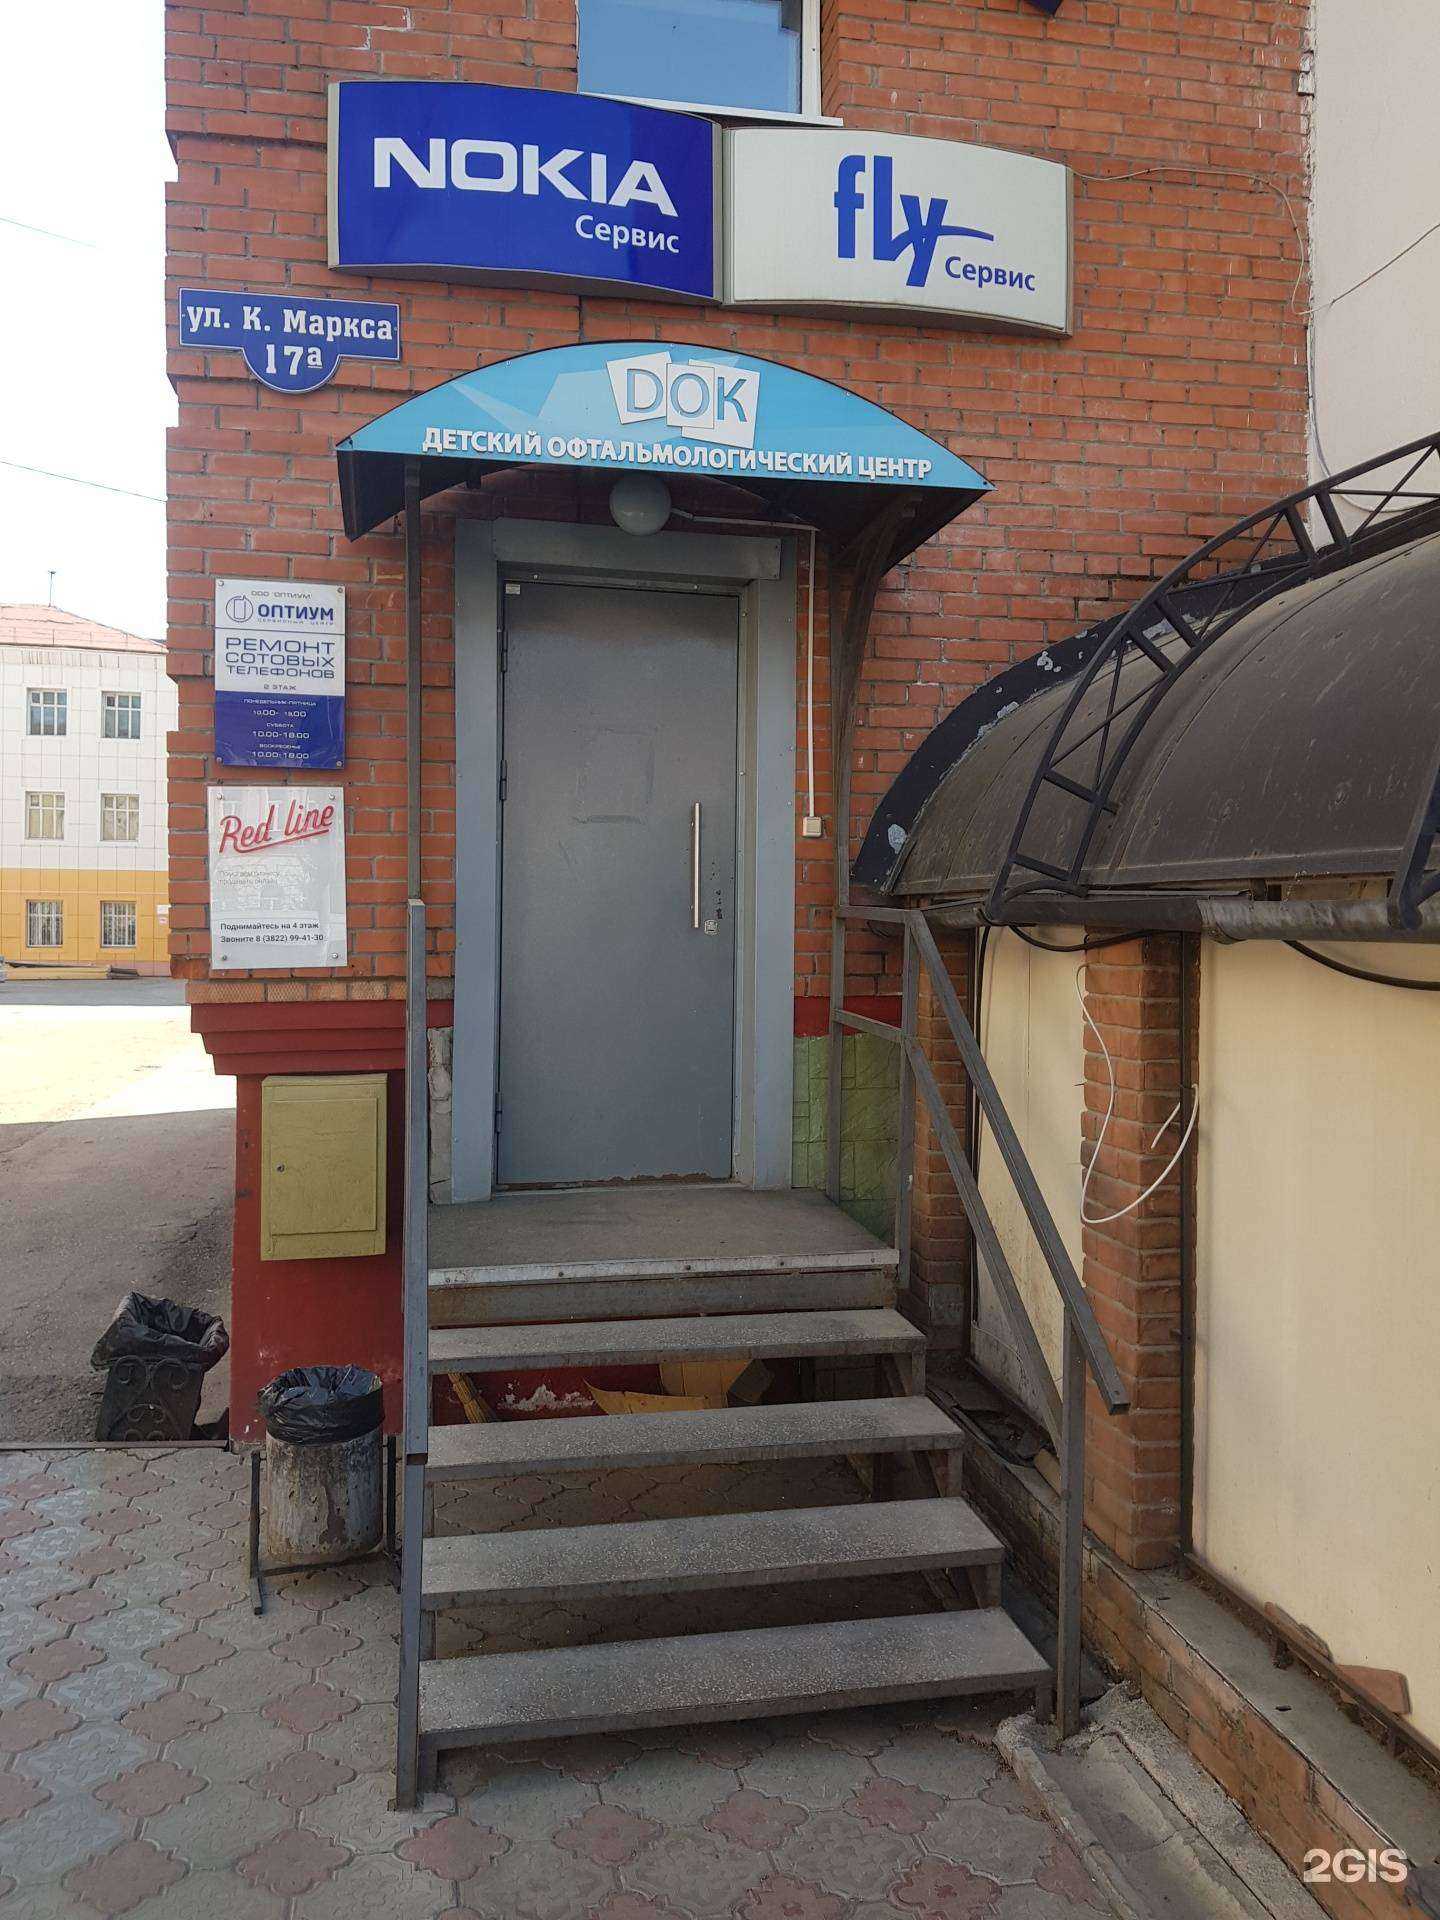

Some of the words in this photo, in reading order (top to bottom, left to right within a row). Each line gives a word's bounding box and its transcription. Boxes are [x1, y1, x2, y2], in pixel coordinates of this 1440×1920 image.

[374, 137, 679, 217] NOKIA
[575, 214, 680, 254] Сервис
[944, 255, 1036, 292] Сервис
[186, 305, 231, 333] ул.
[242, 305, 271, 332] К.
[282, 308, 393, 342] Маркса
[265, 343, 323, 376] 17а
[422, 427, 543, 457] ДЕТСКИЙ
[546, 436, 853, 476] ОФТАЛЬМОЛОГИЧЕСКИЙ
[857, 455, 933, 481] ЦЕНТР
[257, 603, 334, 621] ОПТИУМ
[226, 637, 335, 655] РЕМОНТ
[225, 652, 335, 668] СОТОВЫХ
[226, 665, 335, 679] ТЕЛЕФОНОВ
[272, 683, 297, 691] ЭТАЖ
[218, 804, 275, 853] Red
[284, 799, 335, 837] line
[220, 923, 280, 931] Поднимайтесь
[220, 935, 254, 943] Звоните
[262, 934, 288, 943] (3822)
